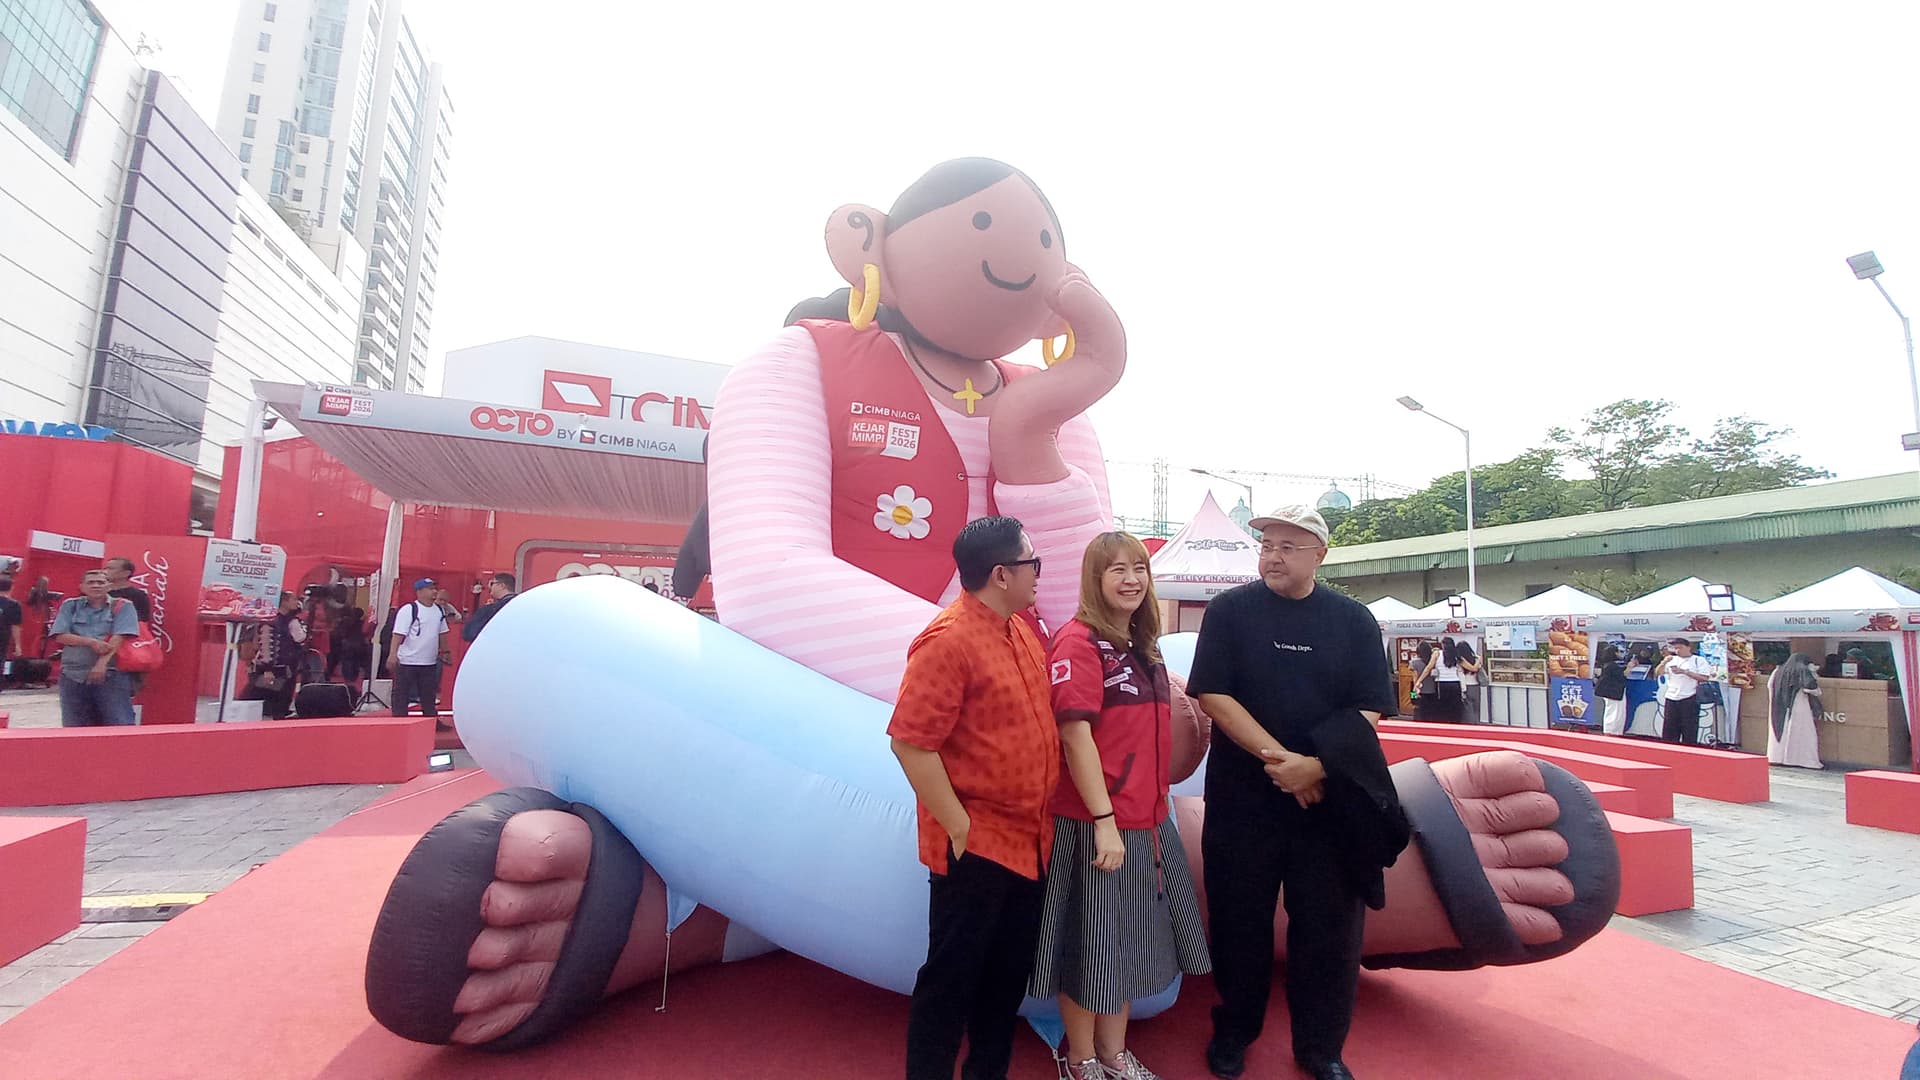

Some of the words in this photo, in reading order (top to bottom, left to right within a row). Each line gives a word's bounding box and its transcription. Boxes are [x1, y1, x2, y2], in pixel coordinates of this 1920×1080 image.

[354, 399, 372, 407] FEST
[470, 406, 554, 436] OCTO
[864, 405, 890, 416] CIMB
[891, 410, 920, 421] NIAGA
[853, 422, 886, 434] KEJAR
[892, 427, 917, 439] FEST
[557, 428, 577, 441] BY
[599, 434, 634, 447] CIMB
[636, 438, 676, 453] NIAGA
[851, 431, 885, 443] MIMPI
[890, 437, 916, 449] 2026
[63, 538, 82, 552] EXIT
[222, 564, 269, 576] EKSKLUSIF
[1808, 616, 1831, 624] MING
